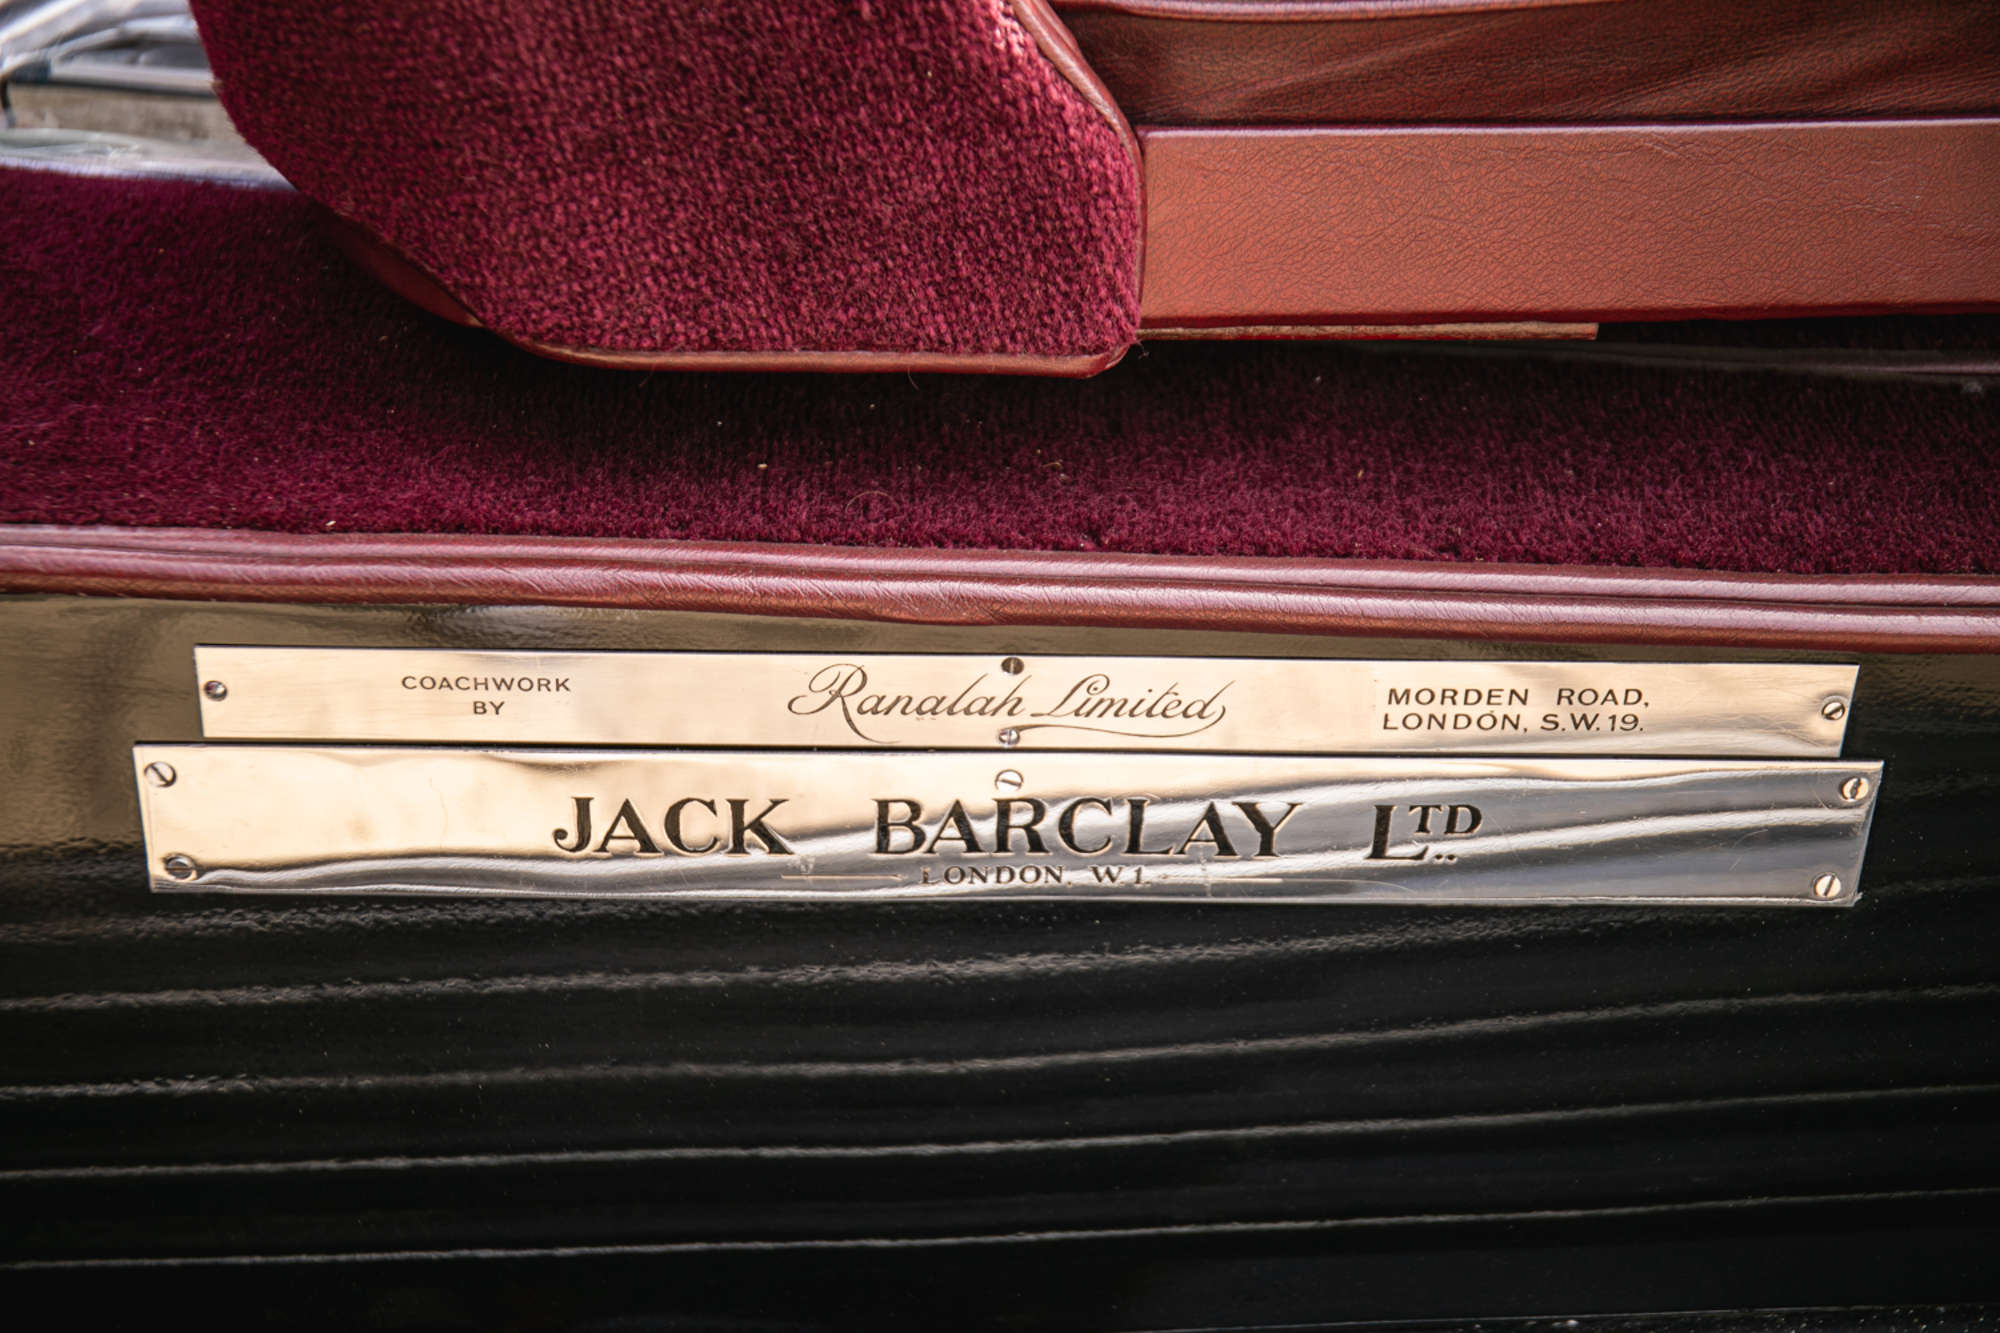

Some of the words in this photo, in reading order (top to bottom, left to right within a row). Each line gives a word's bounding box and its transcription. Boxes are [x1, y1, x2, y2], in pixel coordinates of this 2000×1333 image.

[401, 676, 571, 692] COACHWORK
[472, 701, 505, 715] BY
[787, 663, 1030, 744] Ranalah
[1020, 673, 1236, 738] Limited
[1387, 687, 1529, 706] MORDEN
[1556, 687, 1650, 708] ROAD,
[1382, 711, 1529, 732] LONDON,
[552, 797, 795, 857] JACK
[871, 797, 1302, 858] BARCLAY
